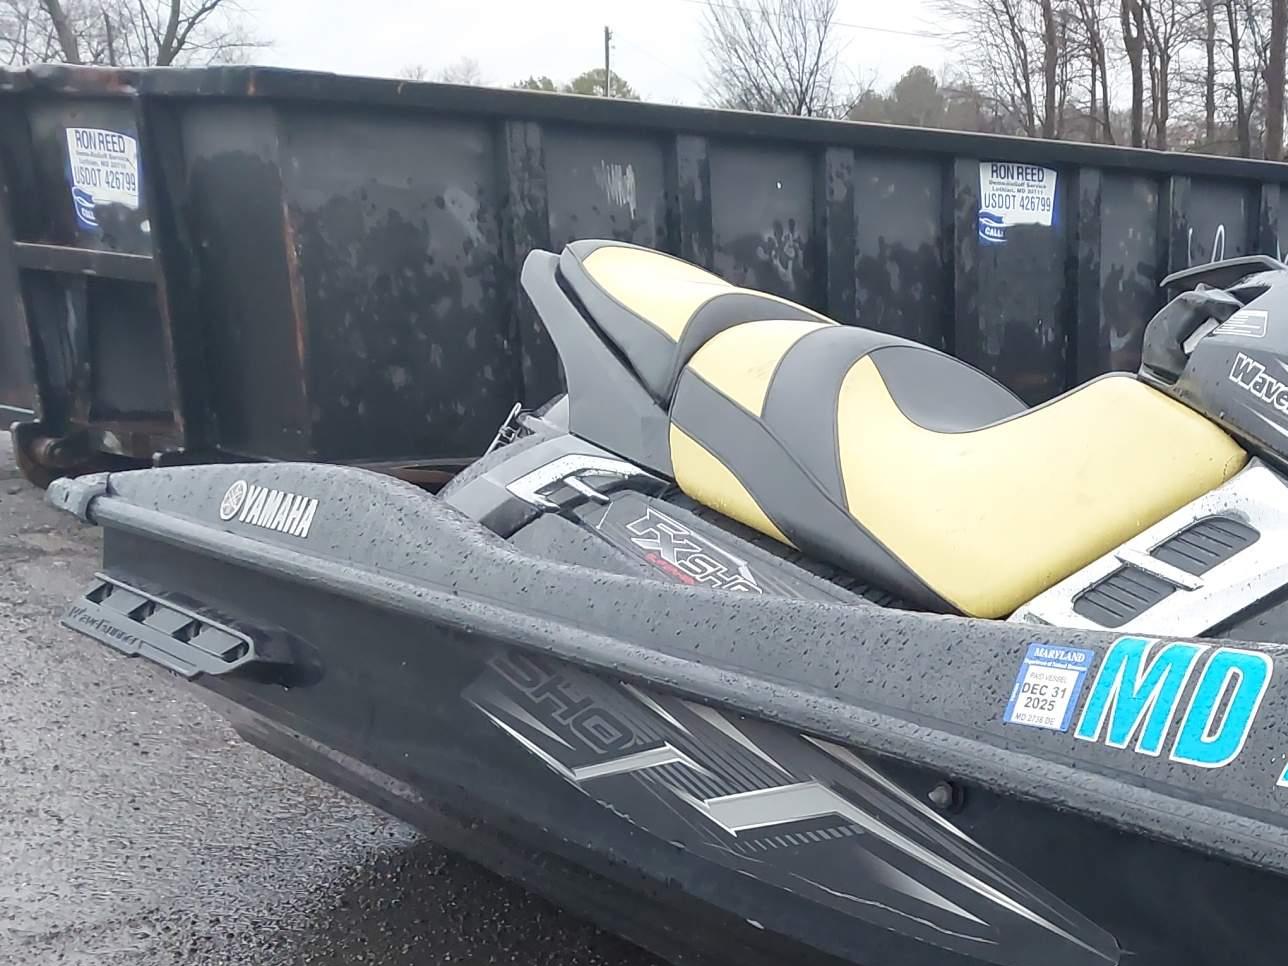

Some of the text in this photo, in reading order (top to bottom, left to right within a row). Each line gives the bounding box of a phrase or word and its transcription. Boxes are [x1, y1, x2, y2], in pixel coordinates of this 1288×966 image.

[74, 130, 126, 153] RON REED
[74, 165, 136, 191] USDOT 426799
[991, 164, 1045, 183] RON REED
[984, 192, 1051, 212] USDOT 426799
[239, 484, 319, 538] YAMAHA
[1034, 647, 1086, 663] MARYLAND
[1022, 682, 1048, 696] DEC
[1051, 686, 1068, 699] 31
[487, 652, 638, 755] SHO
[1023, 696, 1056, 712] 2025
[1073, 635, 1275, 769] MD
